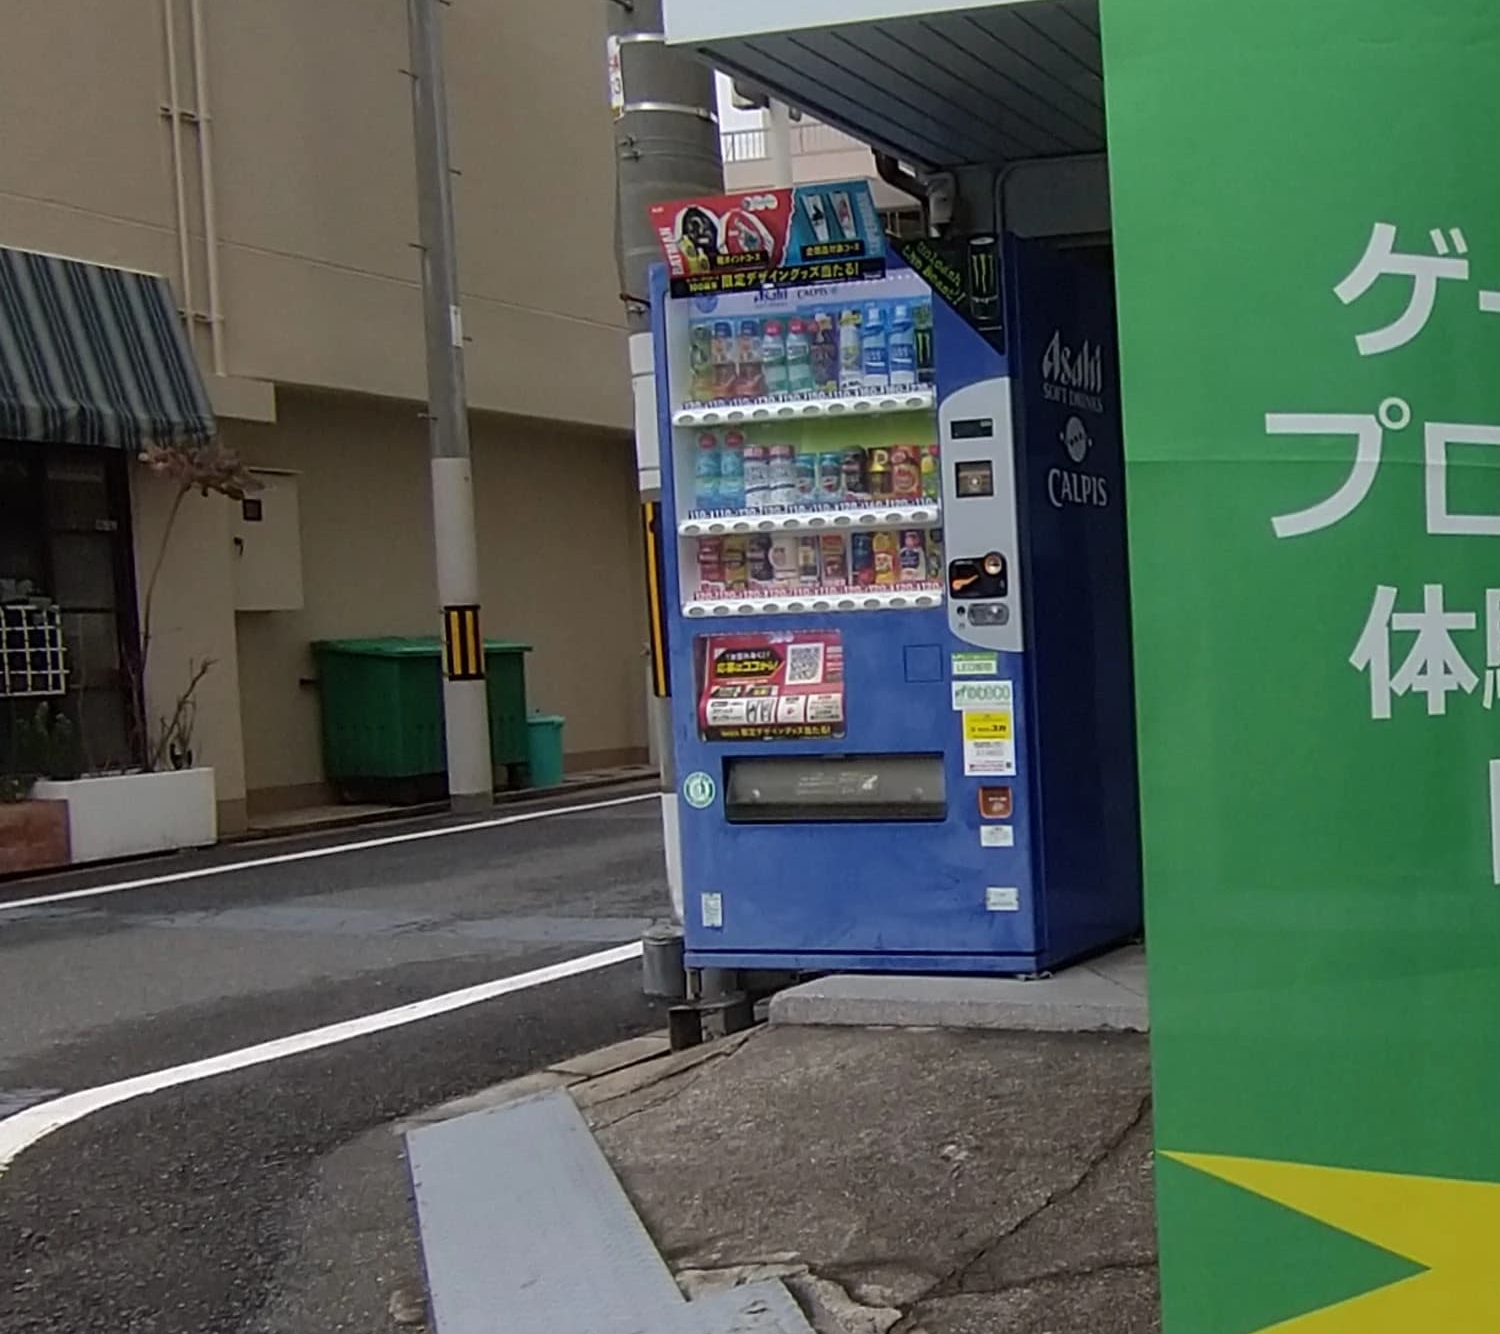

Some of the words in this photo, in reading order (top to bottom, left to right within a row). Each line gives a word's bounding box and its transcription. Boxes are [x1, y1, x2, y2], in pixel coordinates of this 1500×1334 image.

[1042, 329, 1103, 394] Asahi
[1043, 382, 1068, 405] SOFT
[1069, 390, 1104, 414] DRINKS
[1048, 468, 1109, 508] CALPIS
